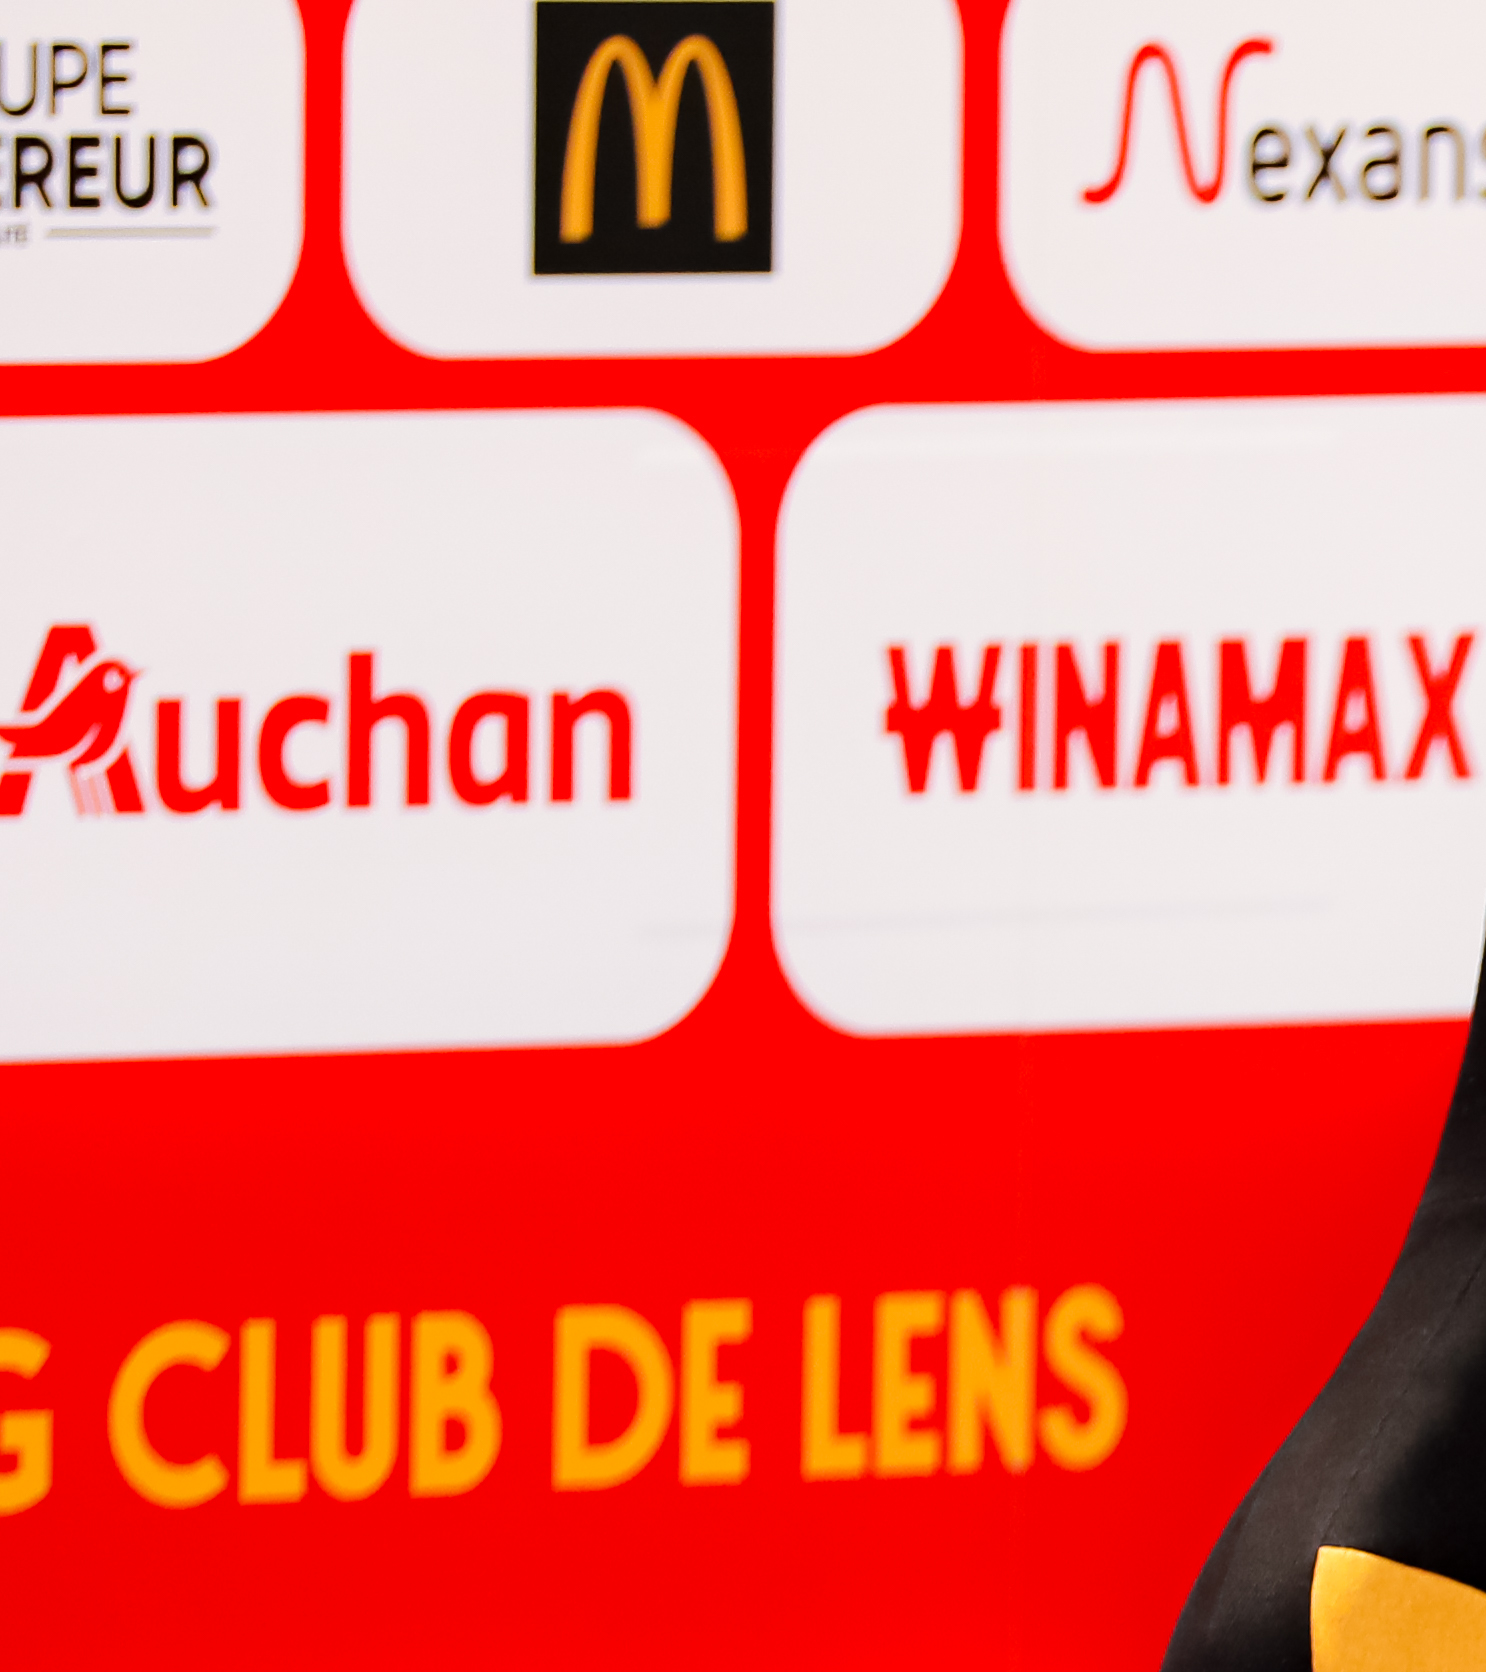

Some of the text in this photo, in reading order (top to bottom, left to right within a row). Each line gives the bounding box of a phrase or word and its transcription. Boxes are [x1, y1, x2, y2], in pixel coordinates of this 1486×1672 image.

[0, 133, 212, 210] REUR
[0, 623, 634, 818] Auchan
[883, 631, 1476, 796] WINAMAX
[108, 1311, 501, 1508] CLUB
[552, 1299, 752, 1490] DE
[801, 1285, 1127, 1480] LENS
